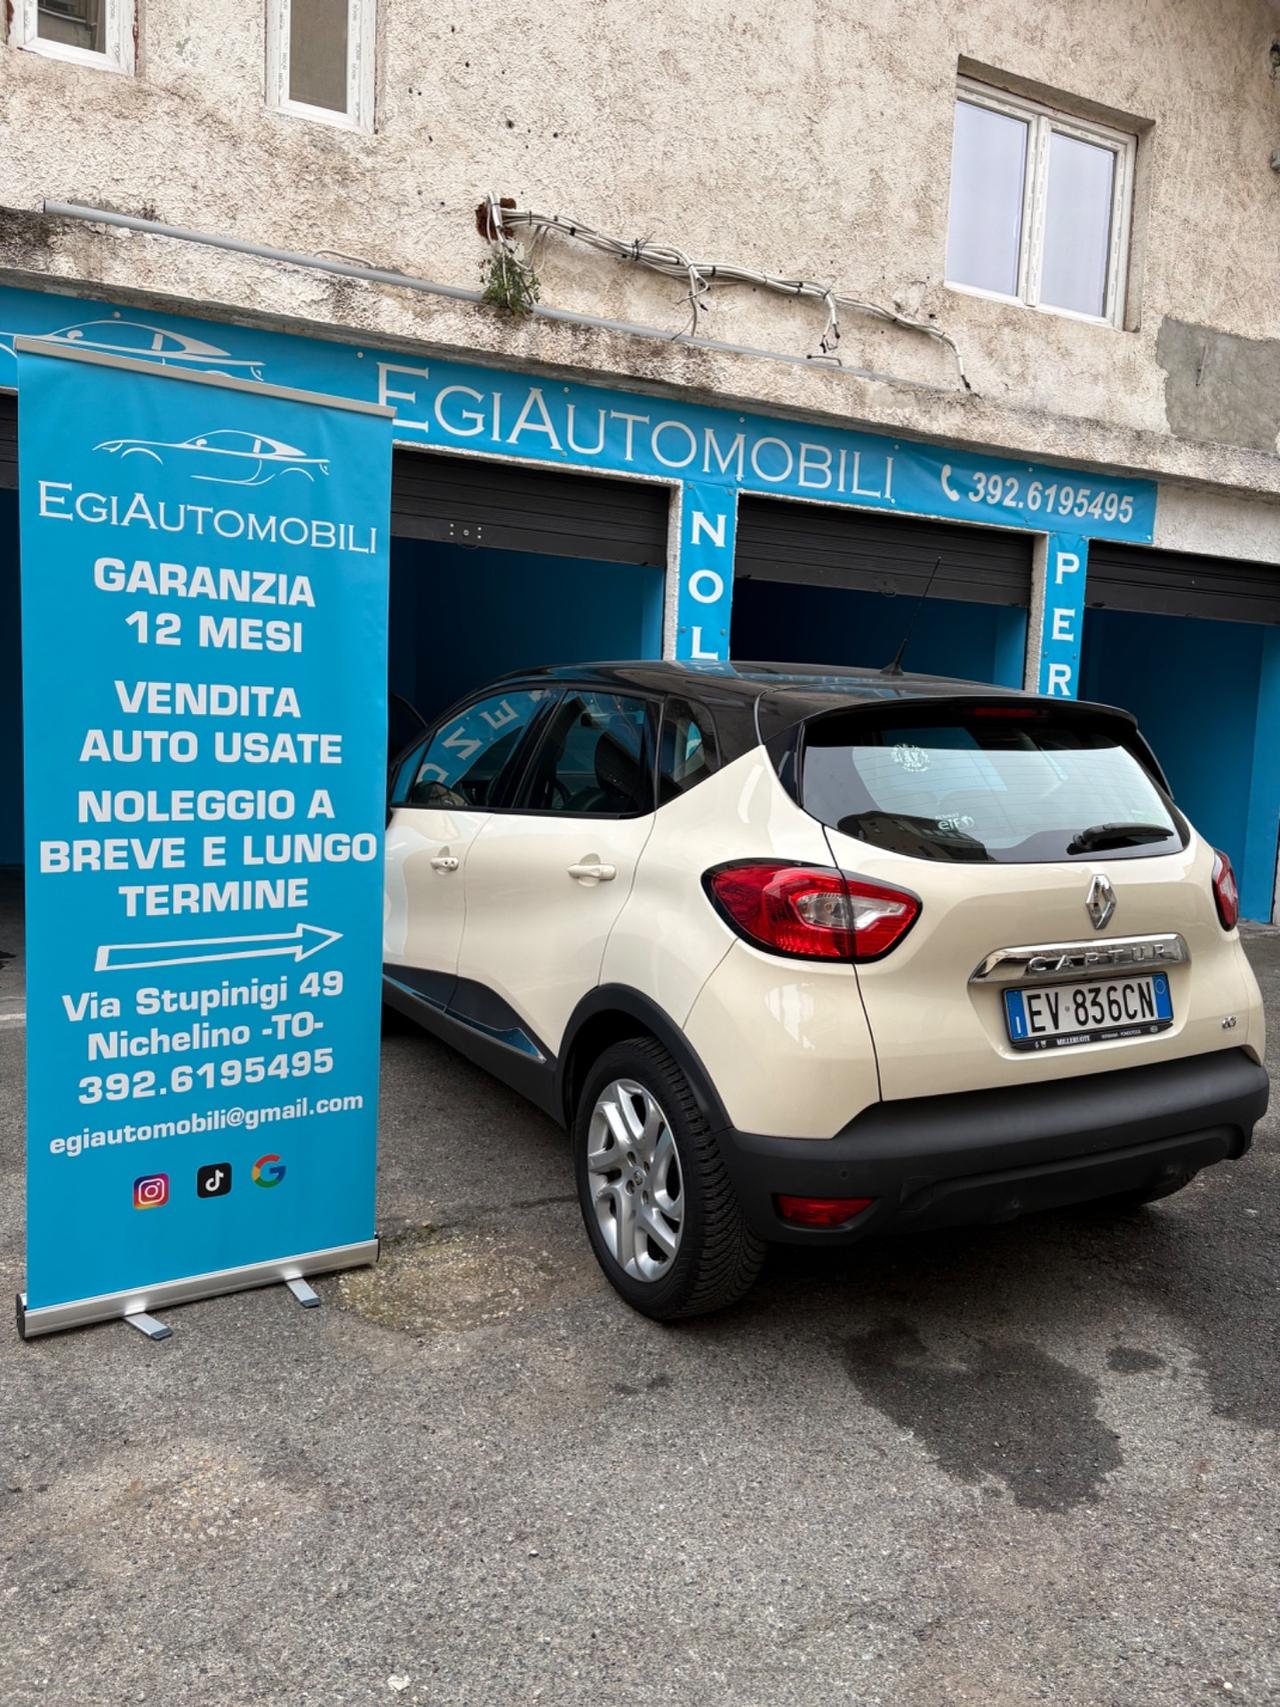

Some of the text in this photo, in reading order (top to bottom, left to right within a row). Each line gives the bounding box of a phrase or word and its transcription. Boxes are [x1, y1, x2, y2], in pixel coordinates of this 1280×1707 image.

[968, 472, 1134, 524] 392.6195495
[94, 557, 316, 608] GARANZIA
[125, 610, 302, 653] 12 MESI
[114, 680, 301, 718] VENDITA
[79, 729, 342, 764] AUTO USATE
[78, 789, 335, 823] NOLEGGIO A
[40, 832, 377, 873] BREVE E LUNGO
[118, 878, 308, 917] TERMINE
[1028, 944, 1171, 971] CAPTUR
[62, 970, 343, 1022] Via Stupinigi 49
[1026, 981, 1156, 1033] EV 836CN
[88, 1011, 324, 1061] Nichelino -TO-
[78, 1047, 334, 1104] 392.6195495
[49, 1095, 363, 1157] egiautomobili@gmail.com
